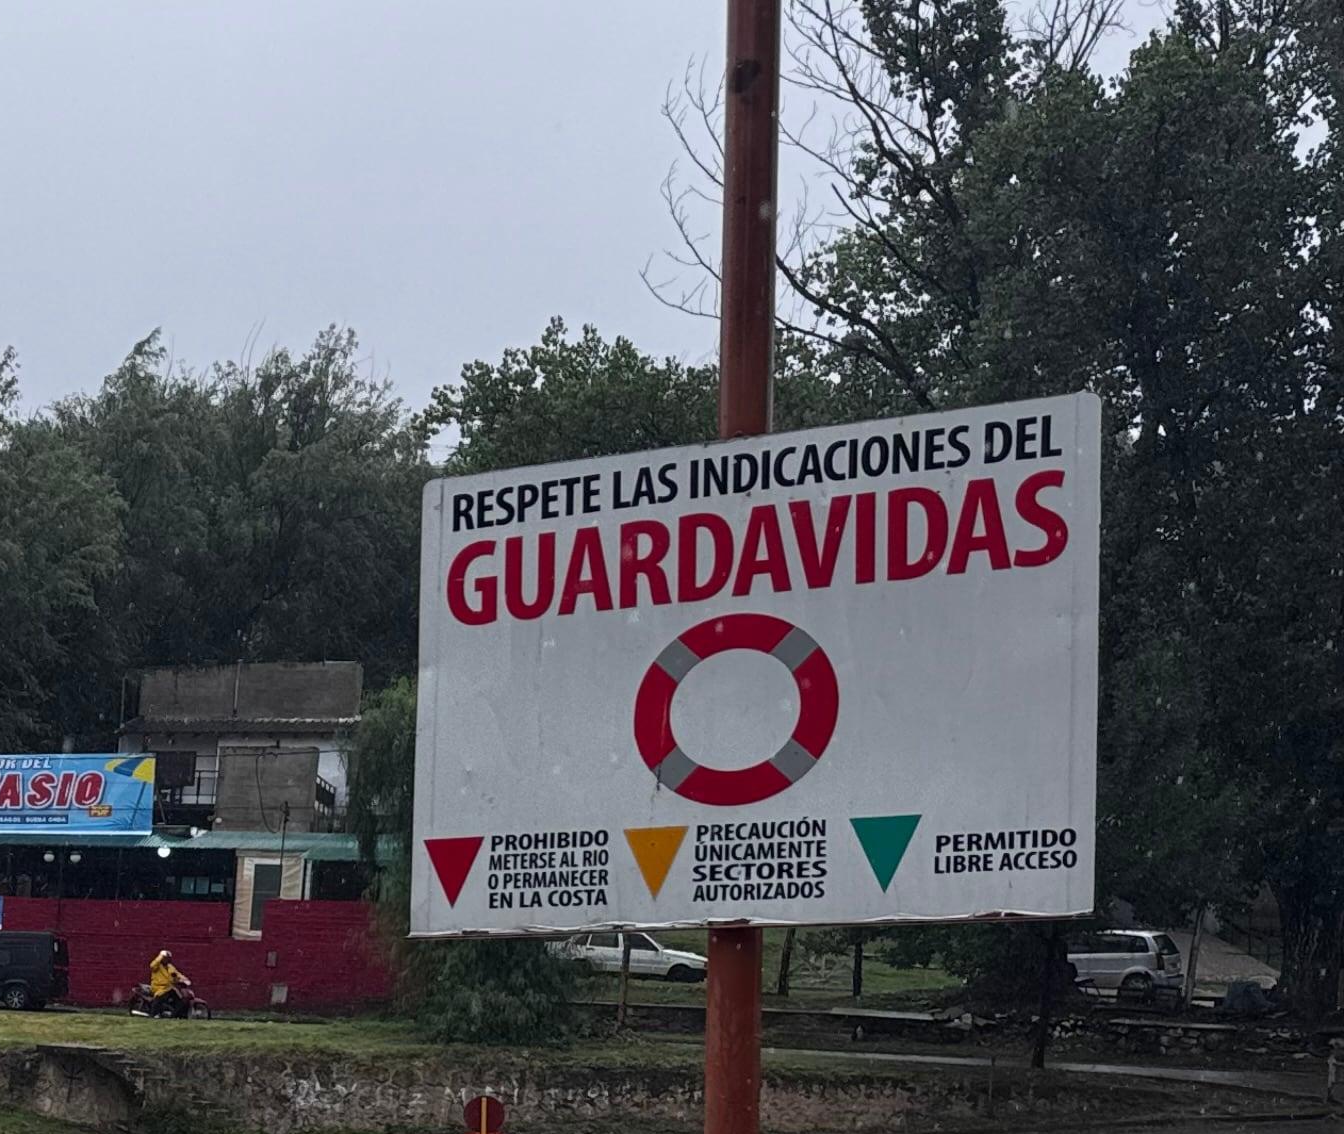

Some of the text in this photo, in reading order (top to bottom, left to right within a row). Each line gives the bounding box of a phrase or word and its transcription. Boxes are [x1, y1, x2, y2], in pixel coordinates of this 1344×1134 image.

[452, 415, 1062, 532] RESPETE LAS INDICACIONES DEL
[447, 470, 1069, 626] GUARDAVIDAS
[21, 757, 52, 769] DEL
[491, 829, 609, 852] PROHIBIDO
[696, 816, 827, 842] PRECAUCIÓN
[935, 828, 1077, 853] PERMITIDO
[488, 849, 609, 871] METERSE AL RIO
[694, 839, 827, 862] ÚNICAMENTE
[934, 849, 1078, 874] LIBRE ACCESO
[488, 869, 609, 890] O PERMANECER
[692, 860, 827, 882] SECTORES
[489, 889, 608, 909] EN LA COSTA
[692, 880, 825, 902] AUTORIZADOS
